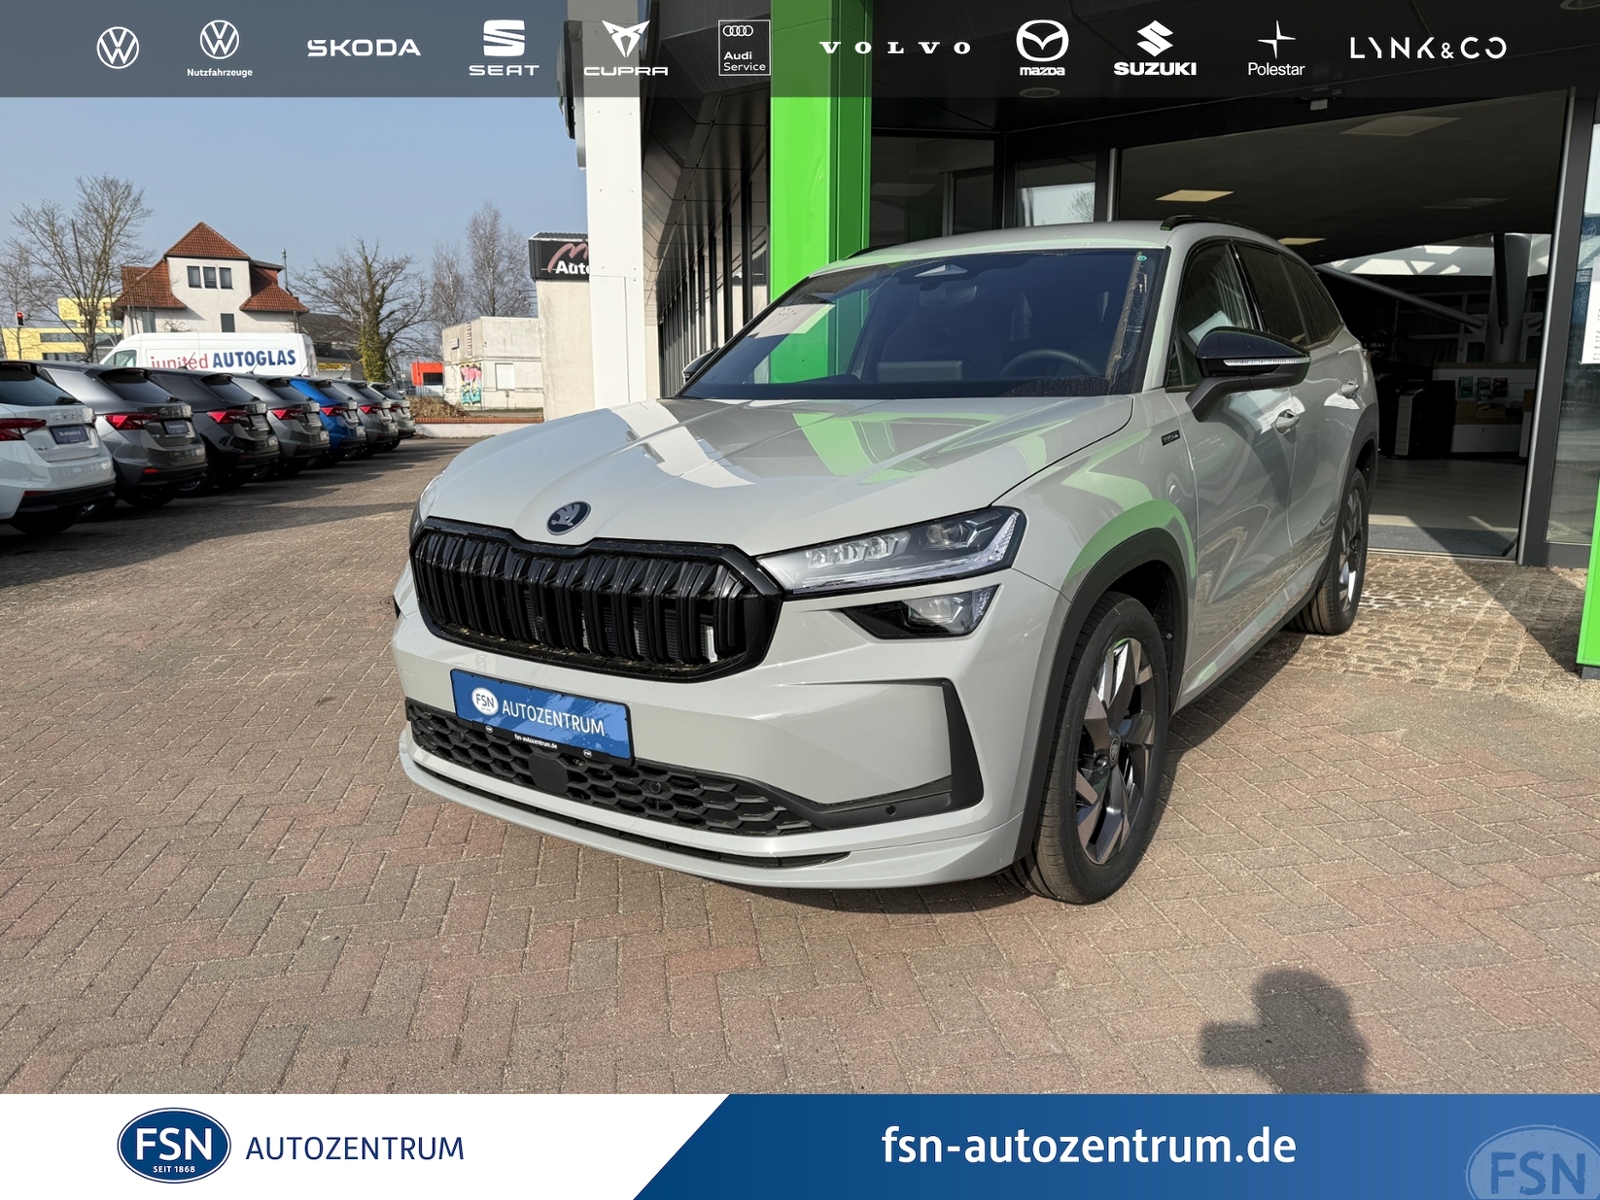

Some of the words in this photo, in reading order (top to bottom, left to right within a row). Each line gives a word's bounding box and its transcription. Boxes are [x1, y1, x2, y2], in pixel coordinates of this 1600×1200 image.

[213, 349, 296, 369] AUTOGLAS
[475, 693, 495, 709] FSN
[502, 699, 606, 737] AUTOZENTRUM
